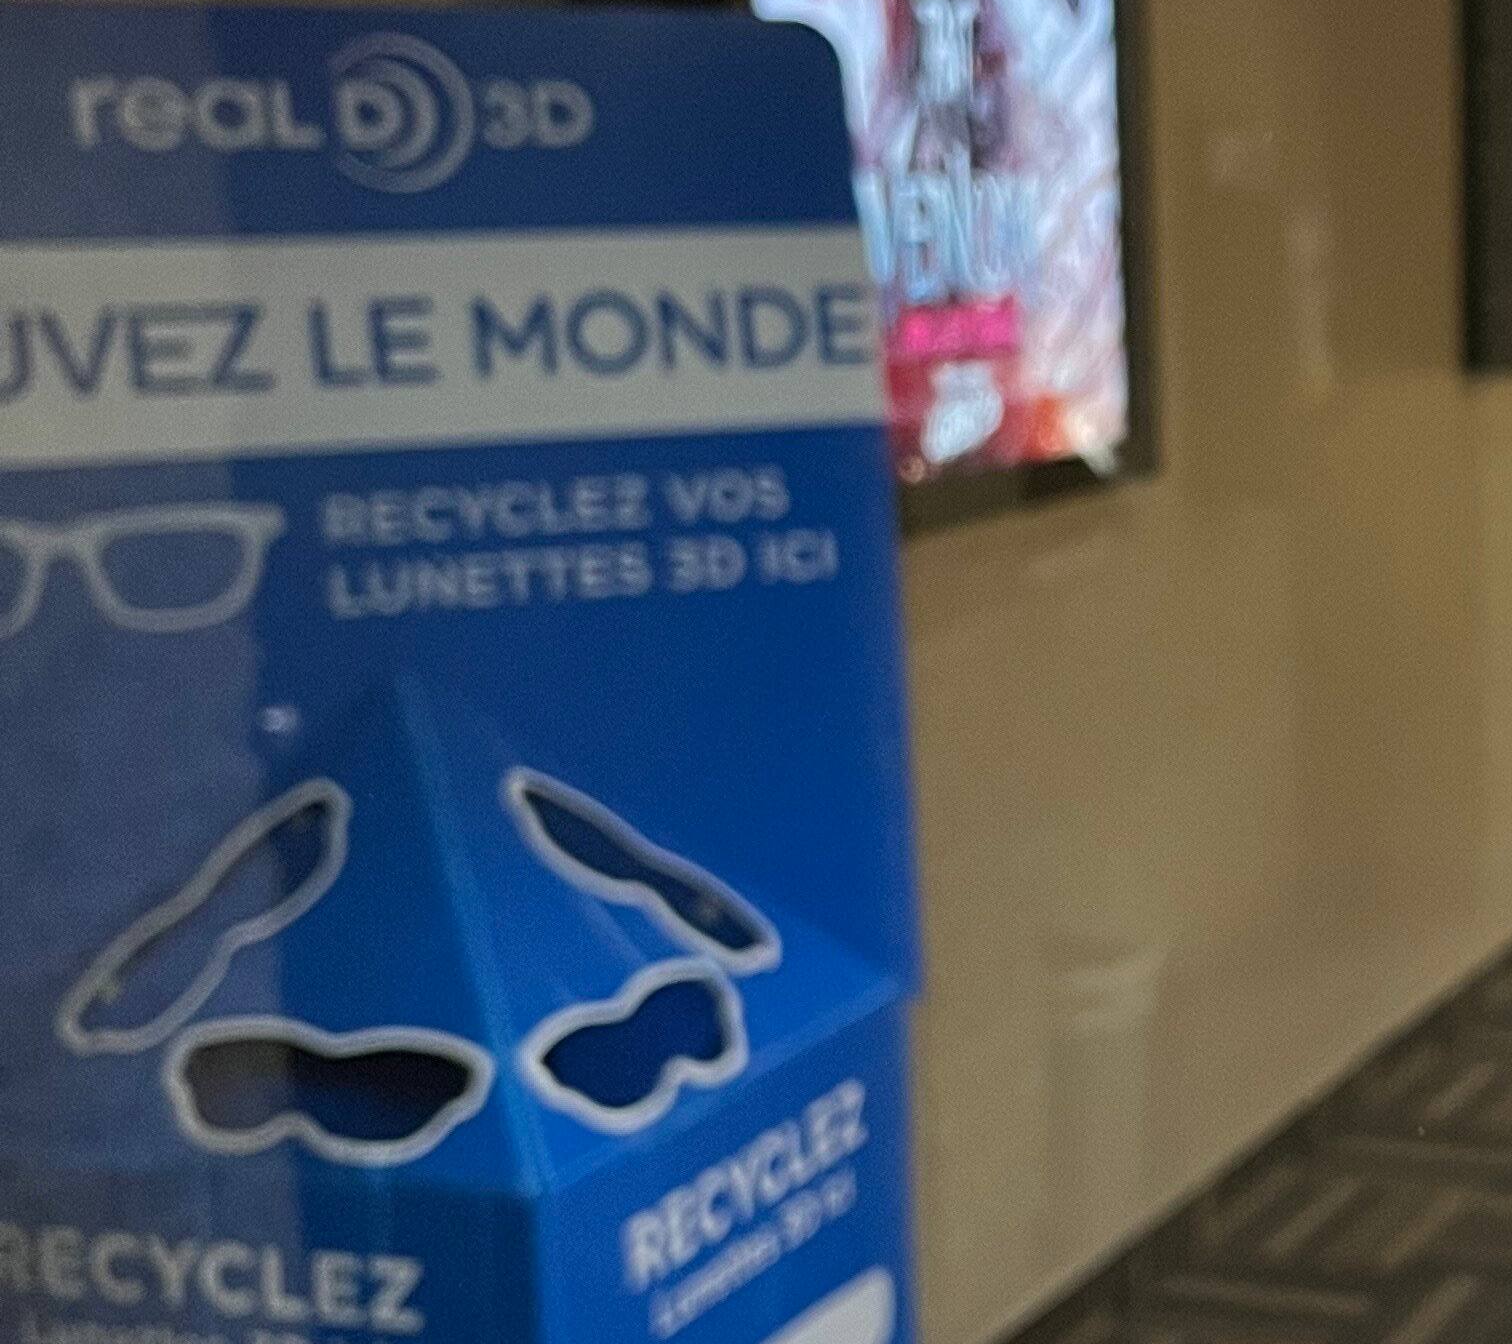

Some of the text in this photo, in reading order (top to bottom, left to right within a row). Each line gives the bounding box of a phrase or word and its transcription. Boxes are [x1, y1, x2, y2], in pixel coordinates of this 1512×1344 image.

[310, 296, 436, 390] LE
[472, 280, 871, 381] MONDE
[322, 464, 790, 549] RECYCLEZ VOS
[328, 527, 837, 621] LUNETTES 3D ICI
[618, 1077, 868, 1296] RECYCLEZ
